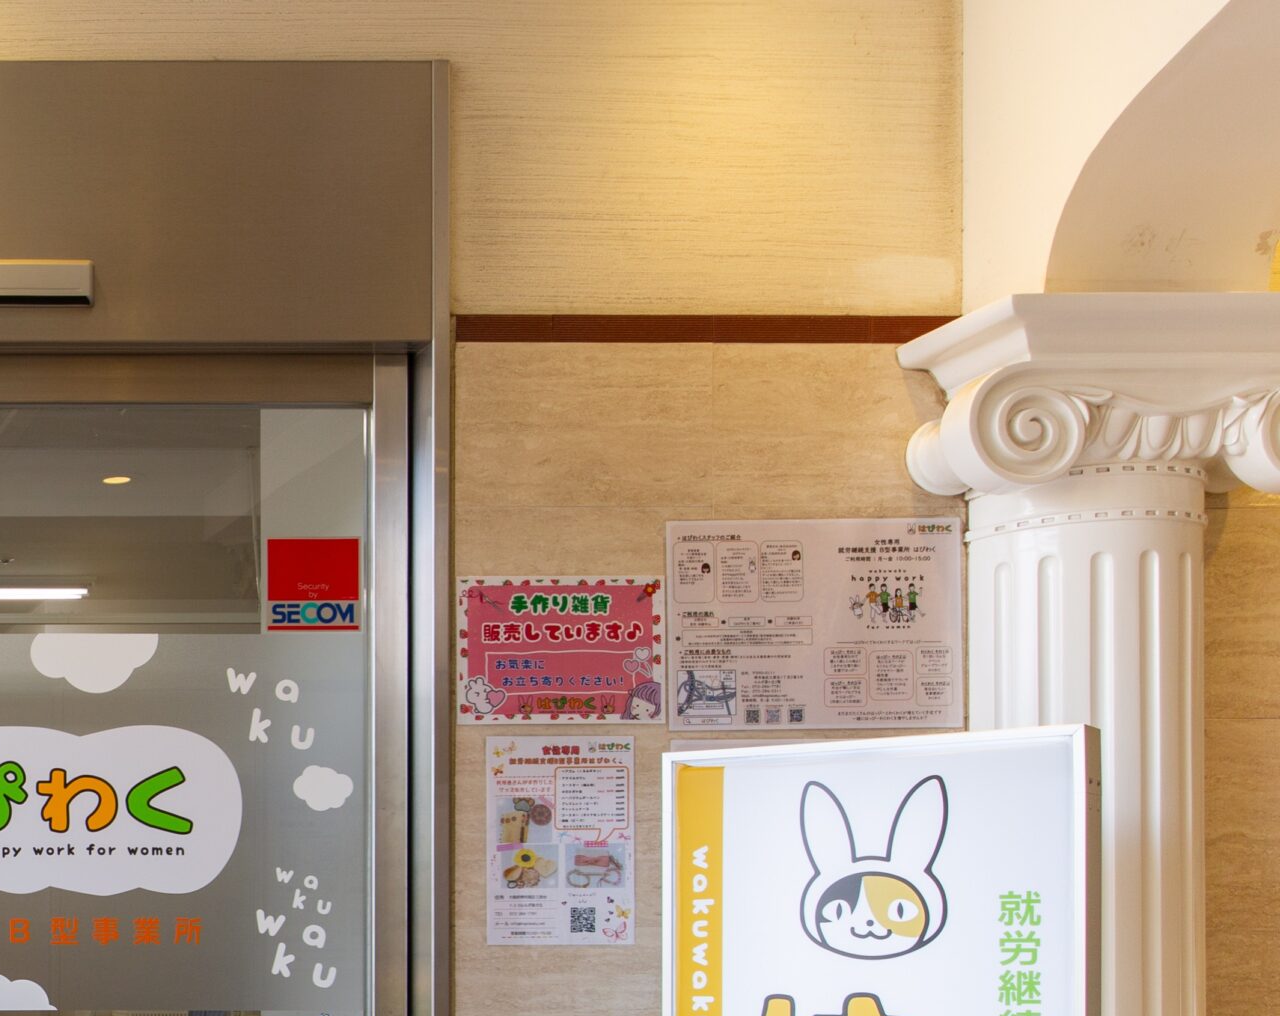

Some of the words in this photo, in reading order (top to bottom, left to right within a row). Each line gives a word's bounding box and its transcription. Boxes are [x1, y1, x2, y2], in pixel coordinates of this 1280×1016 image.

[918, 524, 952, 532] はぴわく
[297, 582, 330, 591] Security
[309, 591, 318, 599] by
[510, 595, 610, 614] 手作り雑貨
[272, 602, 355, 624] SECOM
[536, 697, 597, 710] はぴわく
[33, 844, 75, 857] work
[86, 844, 116, 857] for
[127, 845, 186, 857] women
